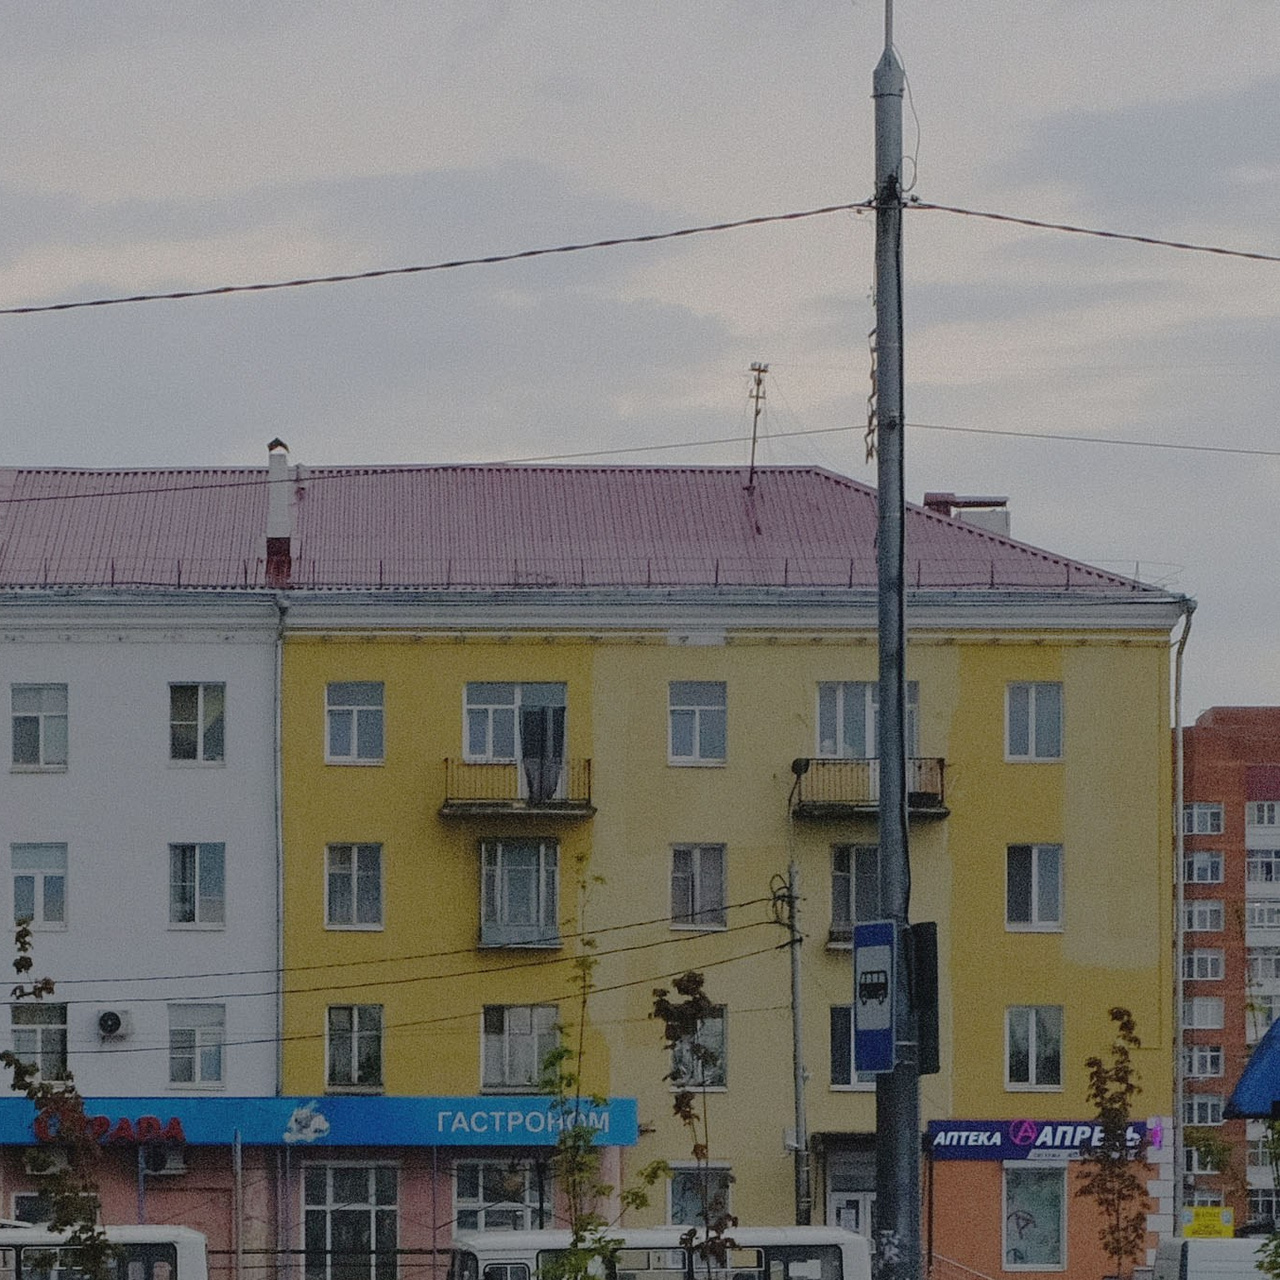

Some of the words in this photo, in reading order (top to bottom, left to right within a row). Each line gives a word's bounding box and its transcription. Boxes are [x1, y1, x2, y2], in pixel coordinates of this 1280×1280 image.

[34, 1106, 186, 1142] ОРАДА
[437, 1111, 610, 1133] ГАСТРОНОМ
[933, 1131, 1002, 1146] АПТЕКА
[1035, 1125, 1141, 1147] АПРЕЬ
